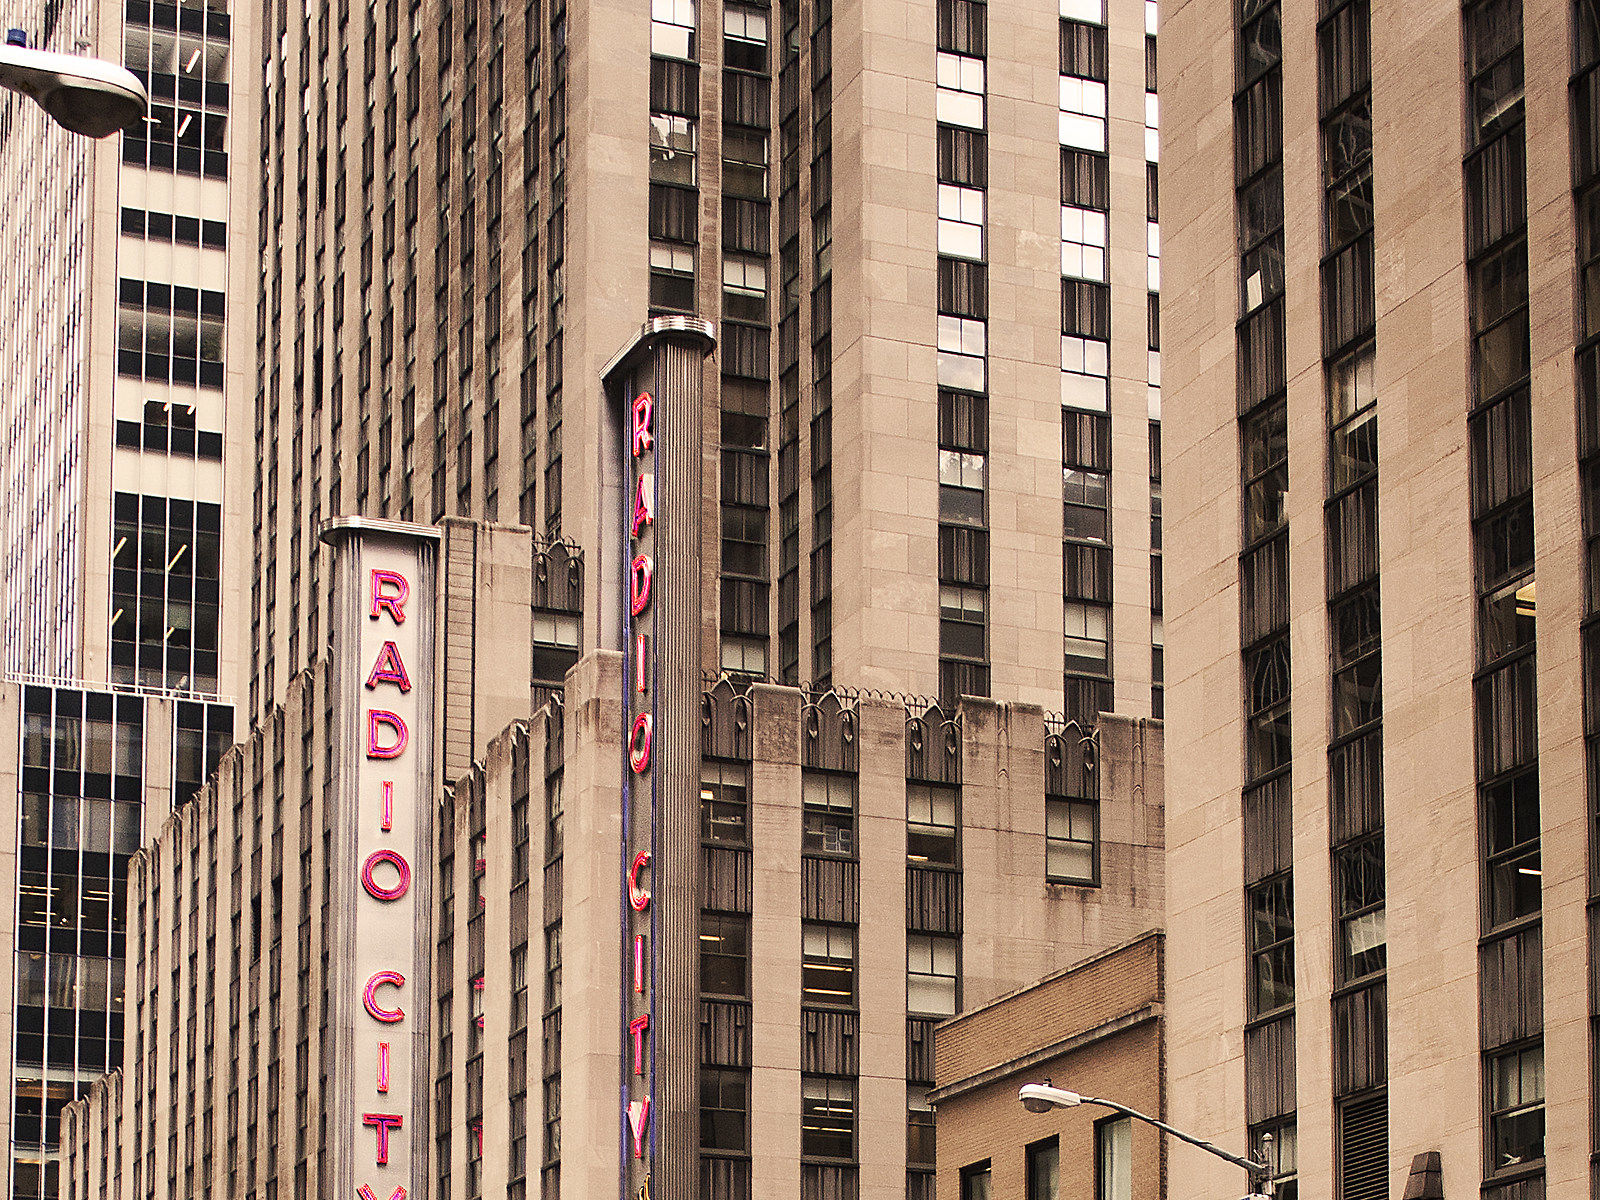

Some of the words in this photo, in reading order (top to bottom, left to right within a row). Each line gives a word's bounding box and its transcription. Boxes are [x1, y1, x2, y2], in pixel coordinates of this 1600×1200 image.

[361, 568, 412, 903] RADIO
[629, 391, 654, 774] RADIO
[627, 850, 652, 1159] CITY
